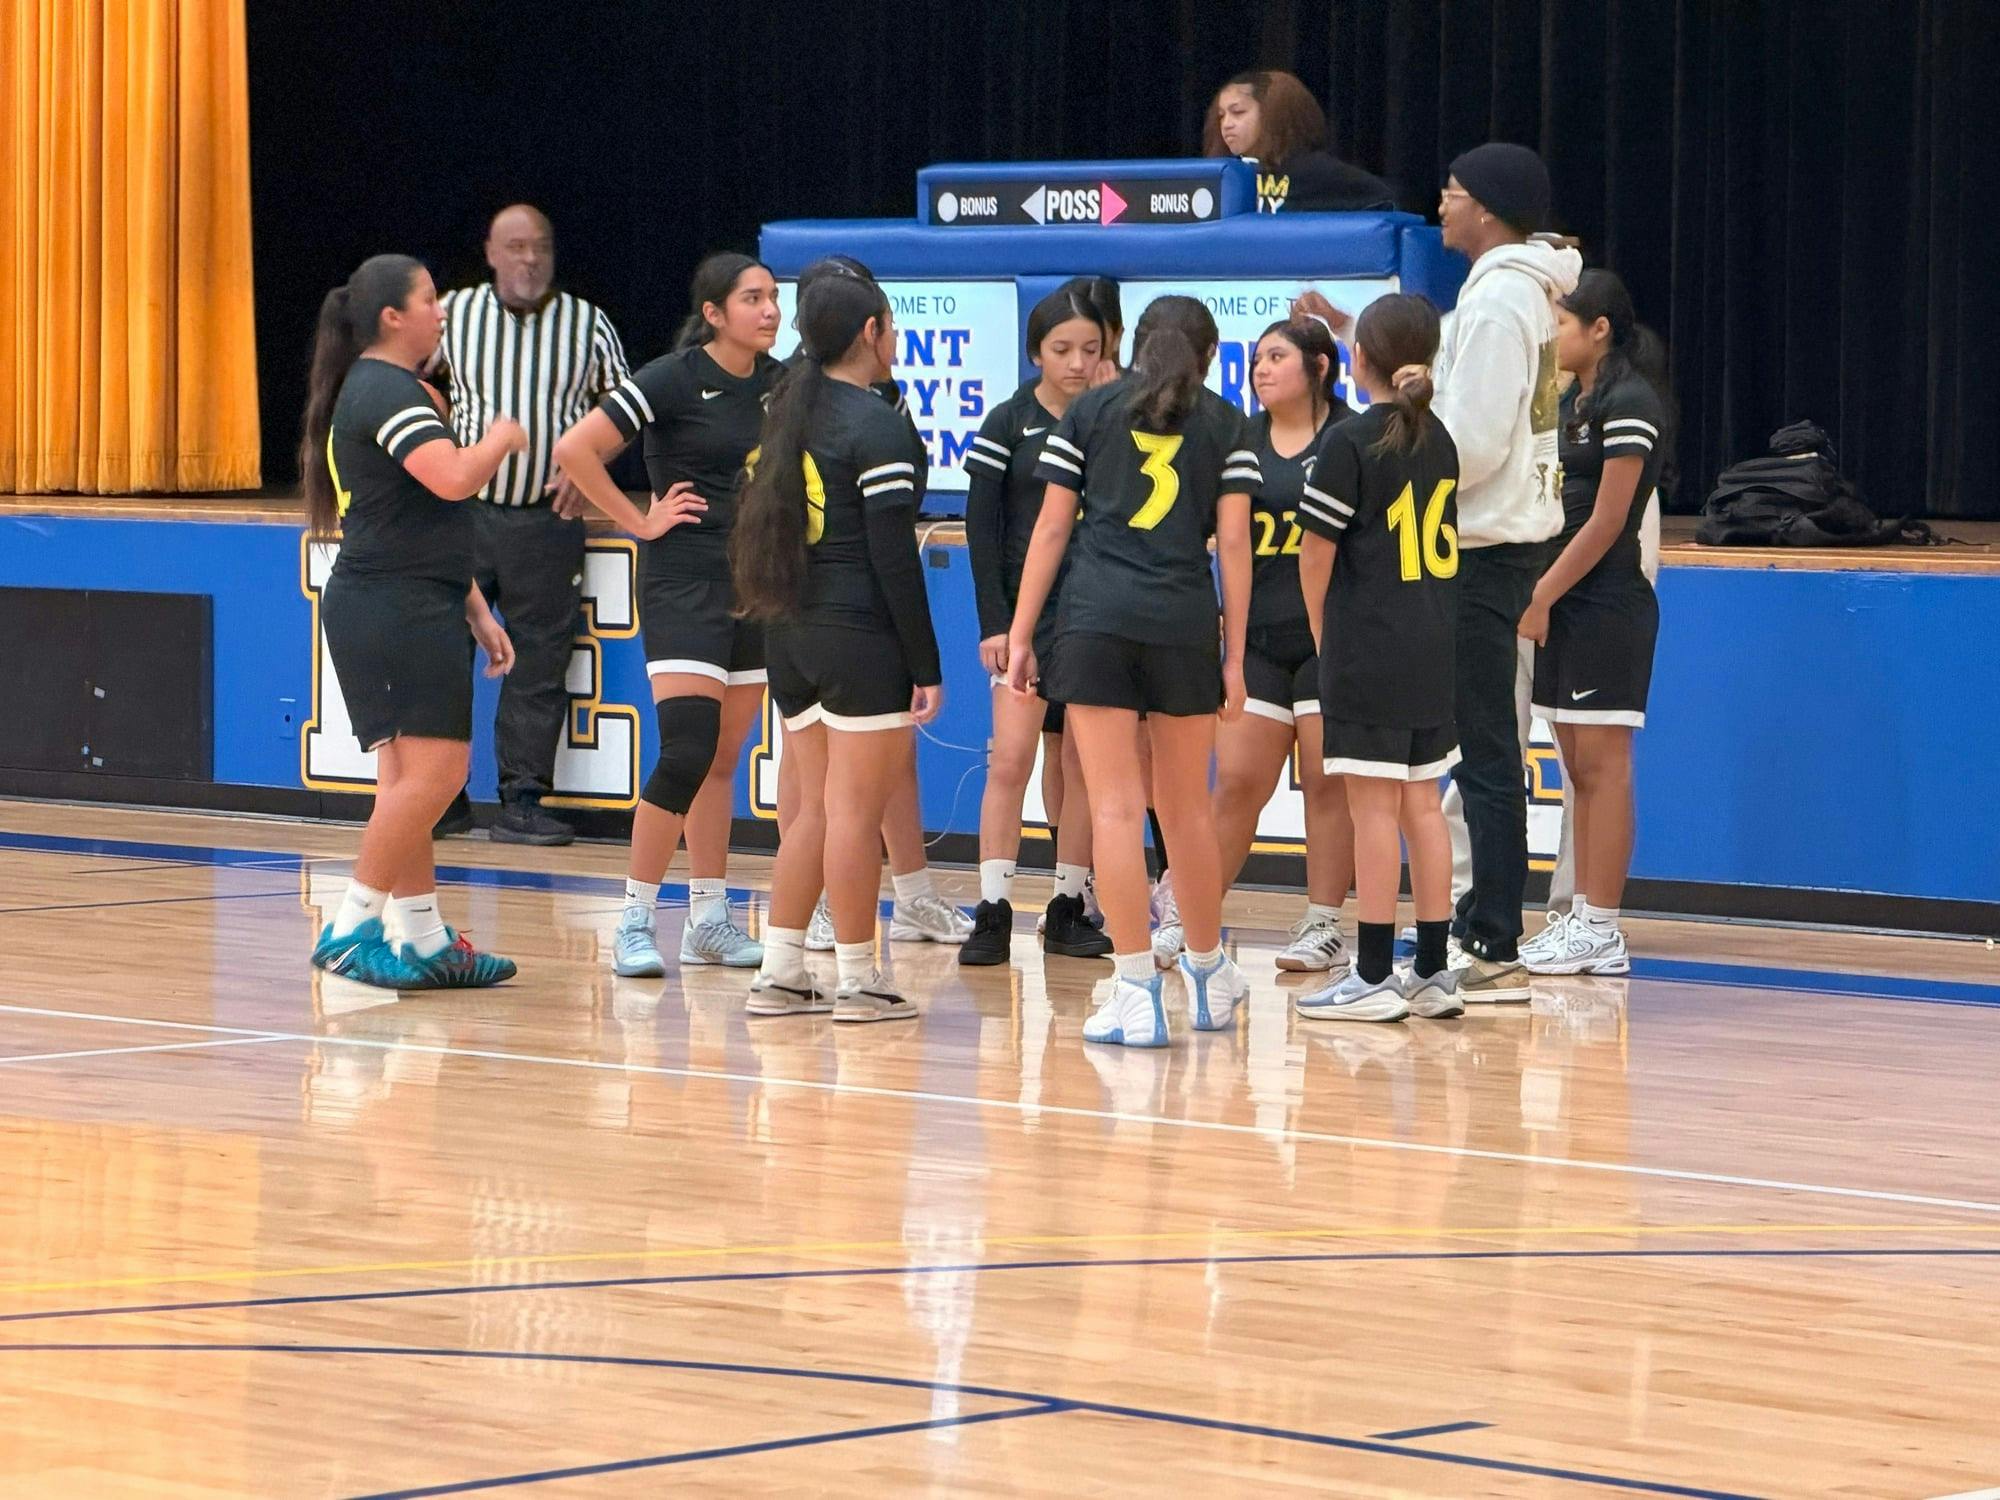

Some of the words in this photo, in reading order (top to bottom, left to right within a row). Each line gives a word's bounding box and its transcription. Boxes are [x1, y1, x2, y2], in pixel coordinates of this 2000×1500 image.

[960, 195, 998, 216] BONUS
[1046, 189, 1100, 221] POSS
[1150, 193, 1189, 214] BONUS
[932, 296, 956, 315] TO
[1200, 296, 1248, 316] OME
[1254, 296, 1279, 316] OF
[895, 378, 984, 417] Y'S
[1128, 430, 1184, 531] 3
[1253, 510, 1303, 556] 22
[1386, 478, 1458, 582] 16
